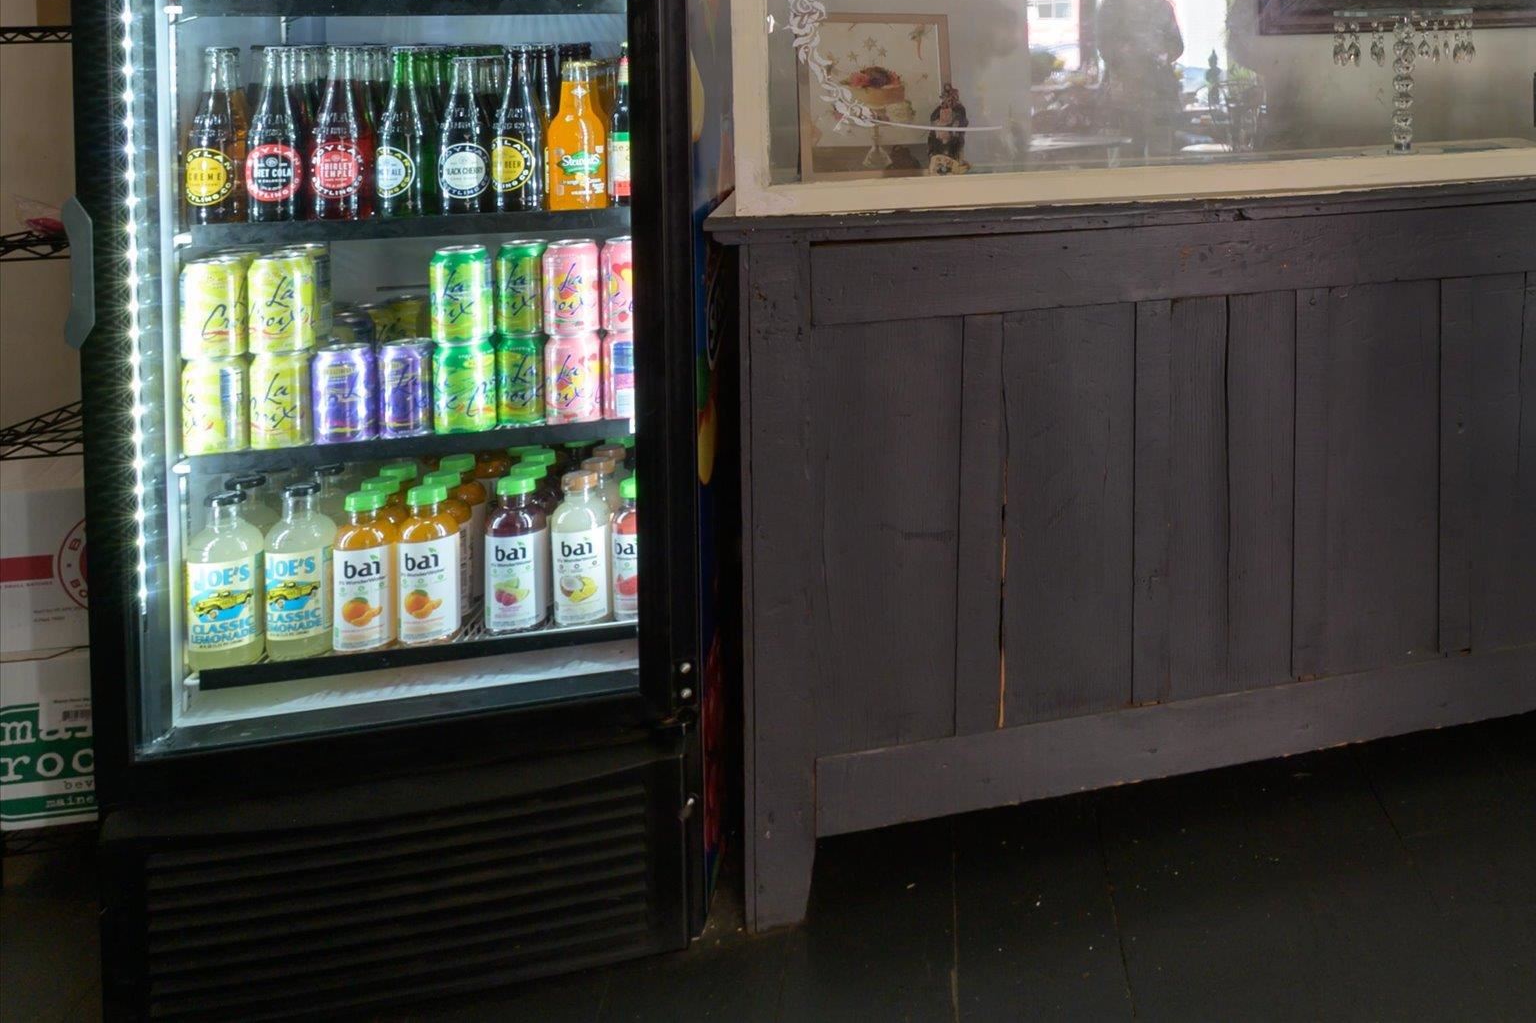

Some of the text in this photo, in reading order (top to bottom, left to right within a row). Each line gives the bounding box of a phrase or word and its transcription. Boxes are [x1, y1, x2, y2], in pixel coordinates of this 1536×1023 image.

[271, 168, 293, 178] COLA
[494, 544, 527, 562] bai
[561, 540, 593, 558] bai
[616, 541, 637, 556] ba
[344, 557, 380, 579] bai
[404, 550, 439, 572] bai
[191, 613, 255, 636] CLASSIC
[191, 625, 257, 645] LEMONADE
